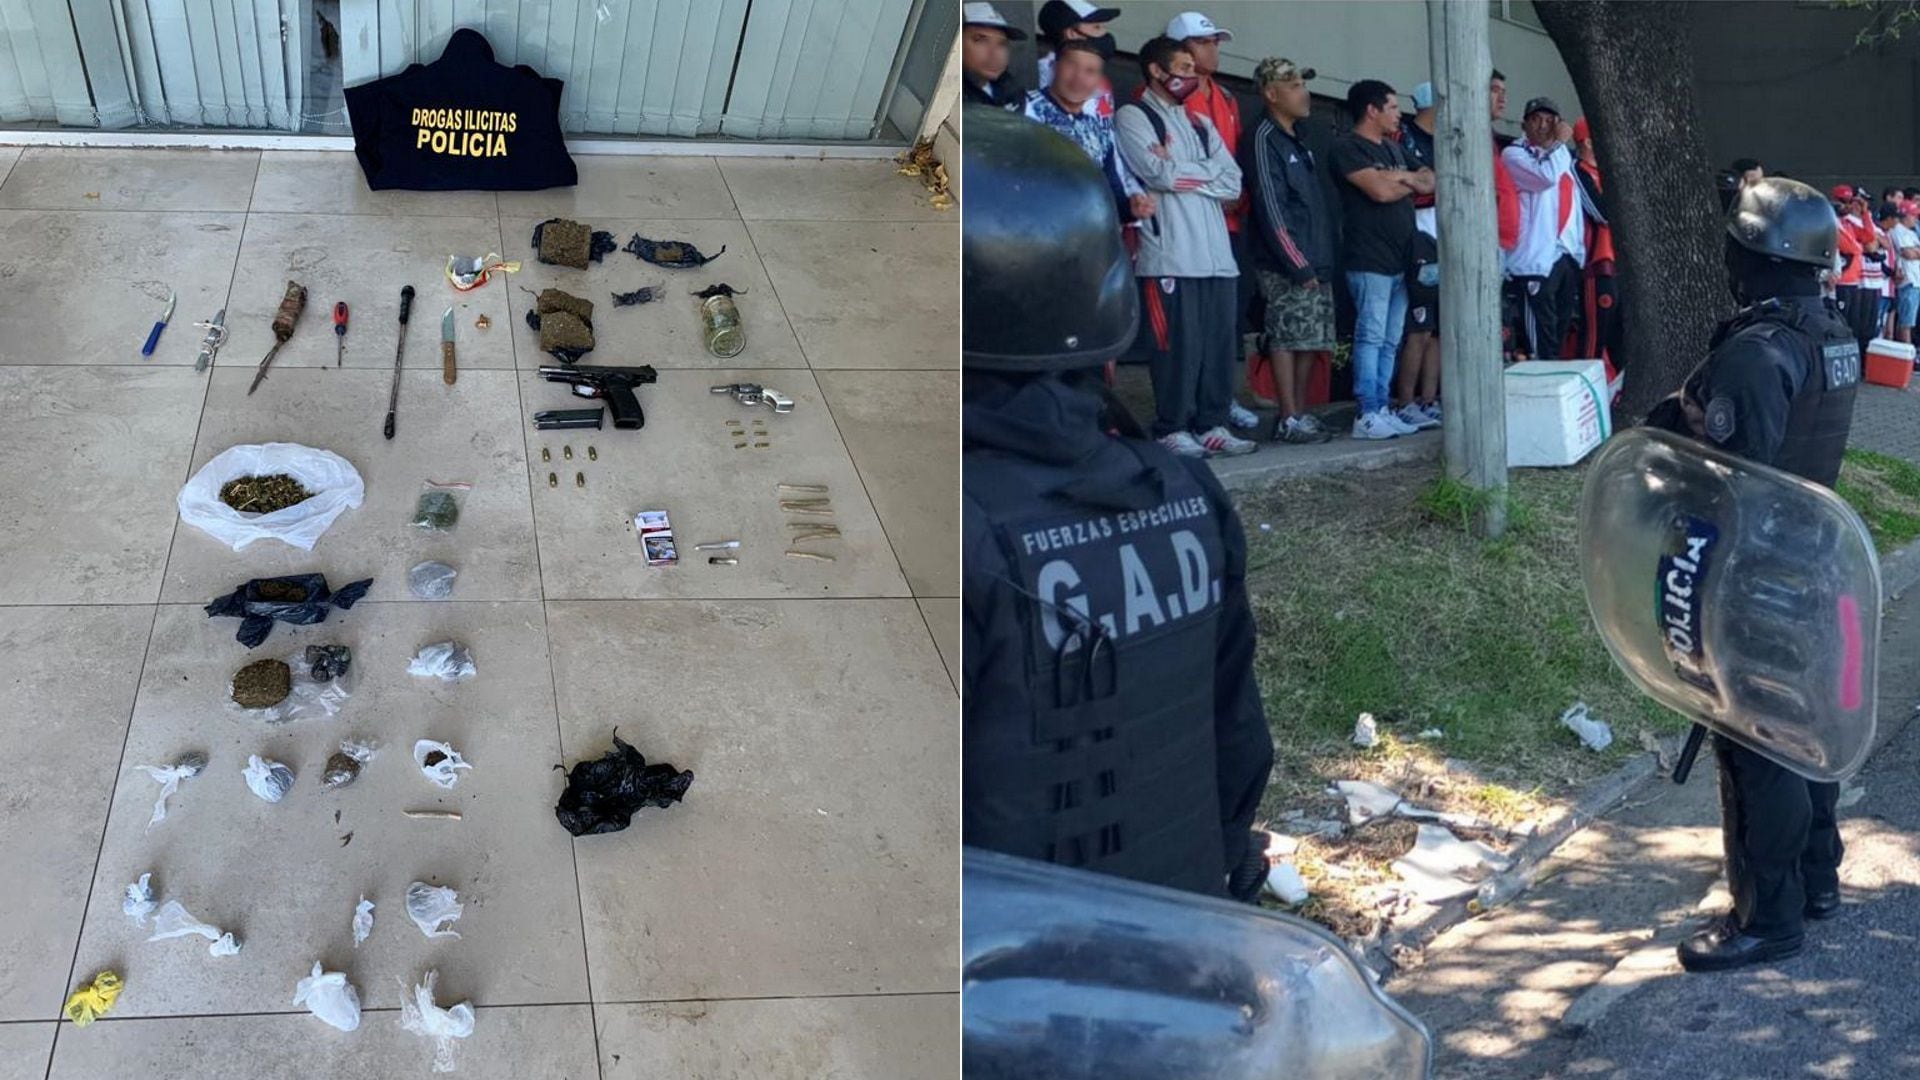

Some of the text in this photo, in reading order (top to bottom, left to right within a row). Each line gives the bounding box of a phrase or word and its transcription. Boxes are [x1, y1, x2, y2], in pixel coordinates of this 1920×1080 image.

[411, 107, 517, 133] DROGAS ILICITAS
[416, 128, 508, 157] POLICIA
[1022, 496, 1208, 554] FUERZAS ESPECIALES
[1037, 529, 1221, 653] G.A.D.
